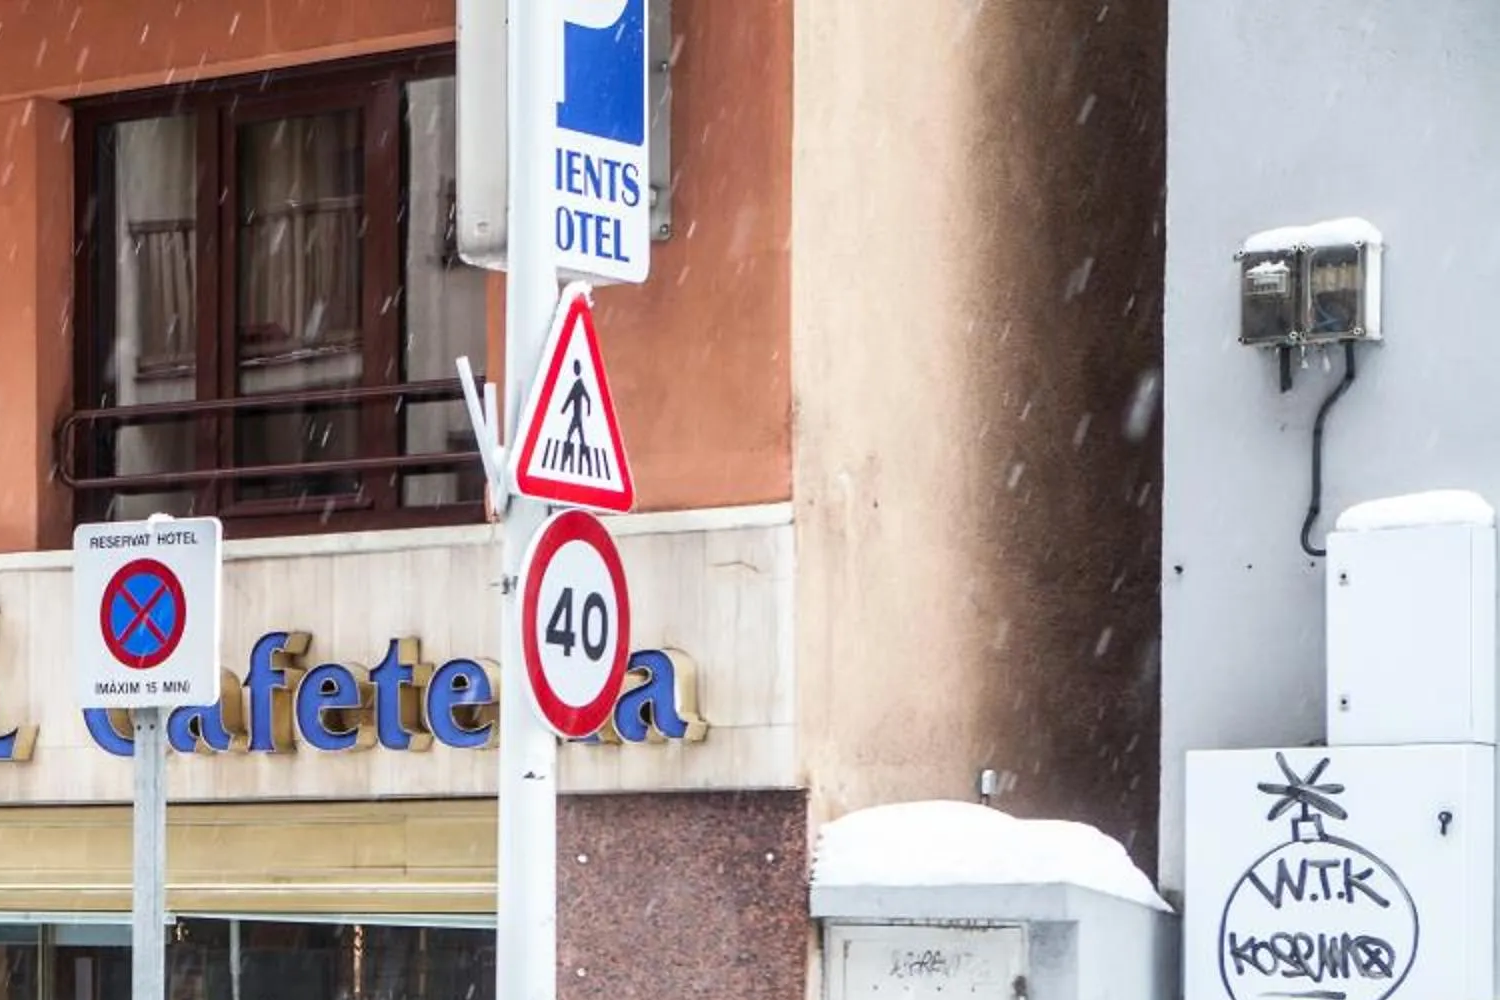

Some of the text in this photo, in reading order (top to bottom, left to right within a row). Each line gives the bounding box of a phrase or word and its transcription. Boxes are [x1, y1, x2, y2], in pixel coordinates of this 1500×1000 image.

[555, 147, 641, 208] IENTS
[555, 205, 631, 264] OTEL
[89, 531, 199, 549] RESERVAT HOTEL
[545, 587, 609, 662] 40
[145, 682, 158, 694] 15
